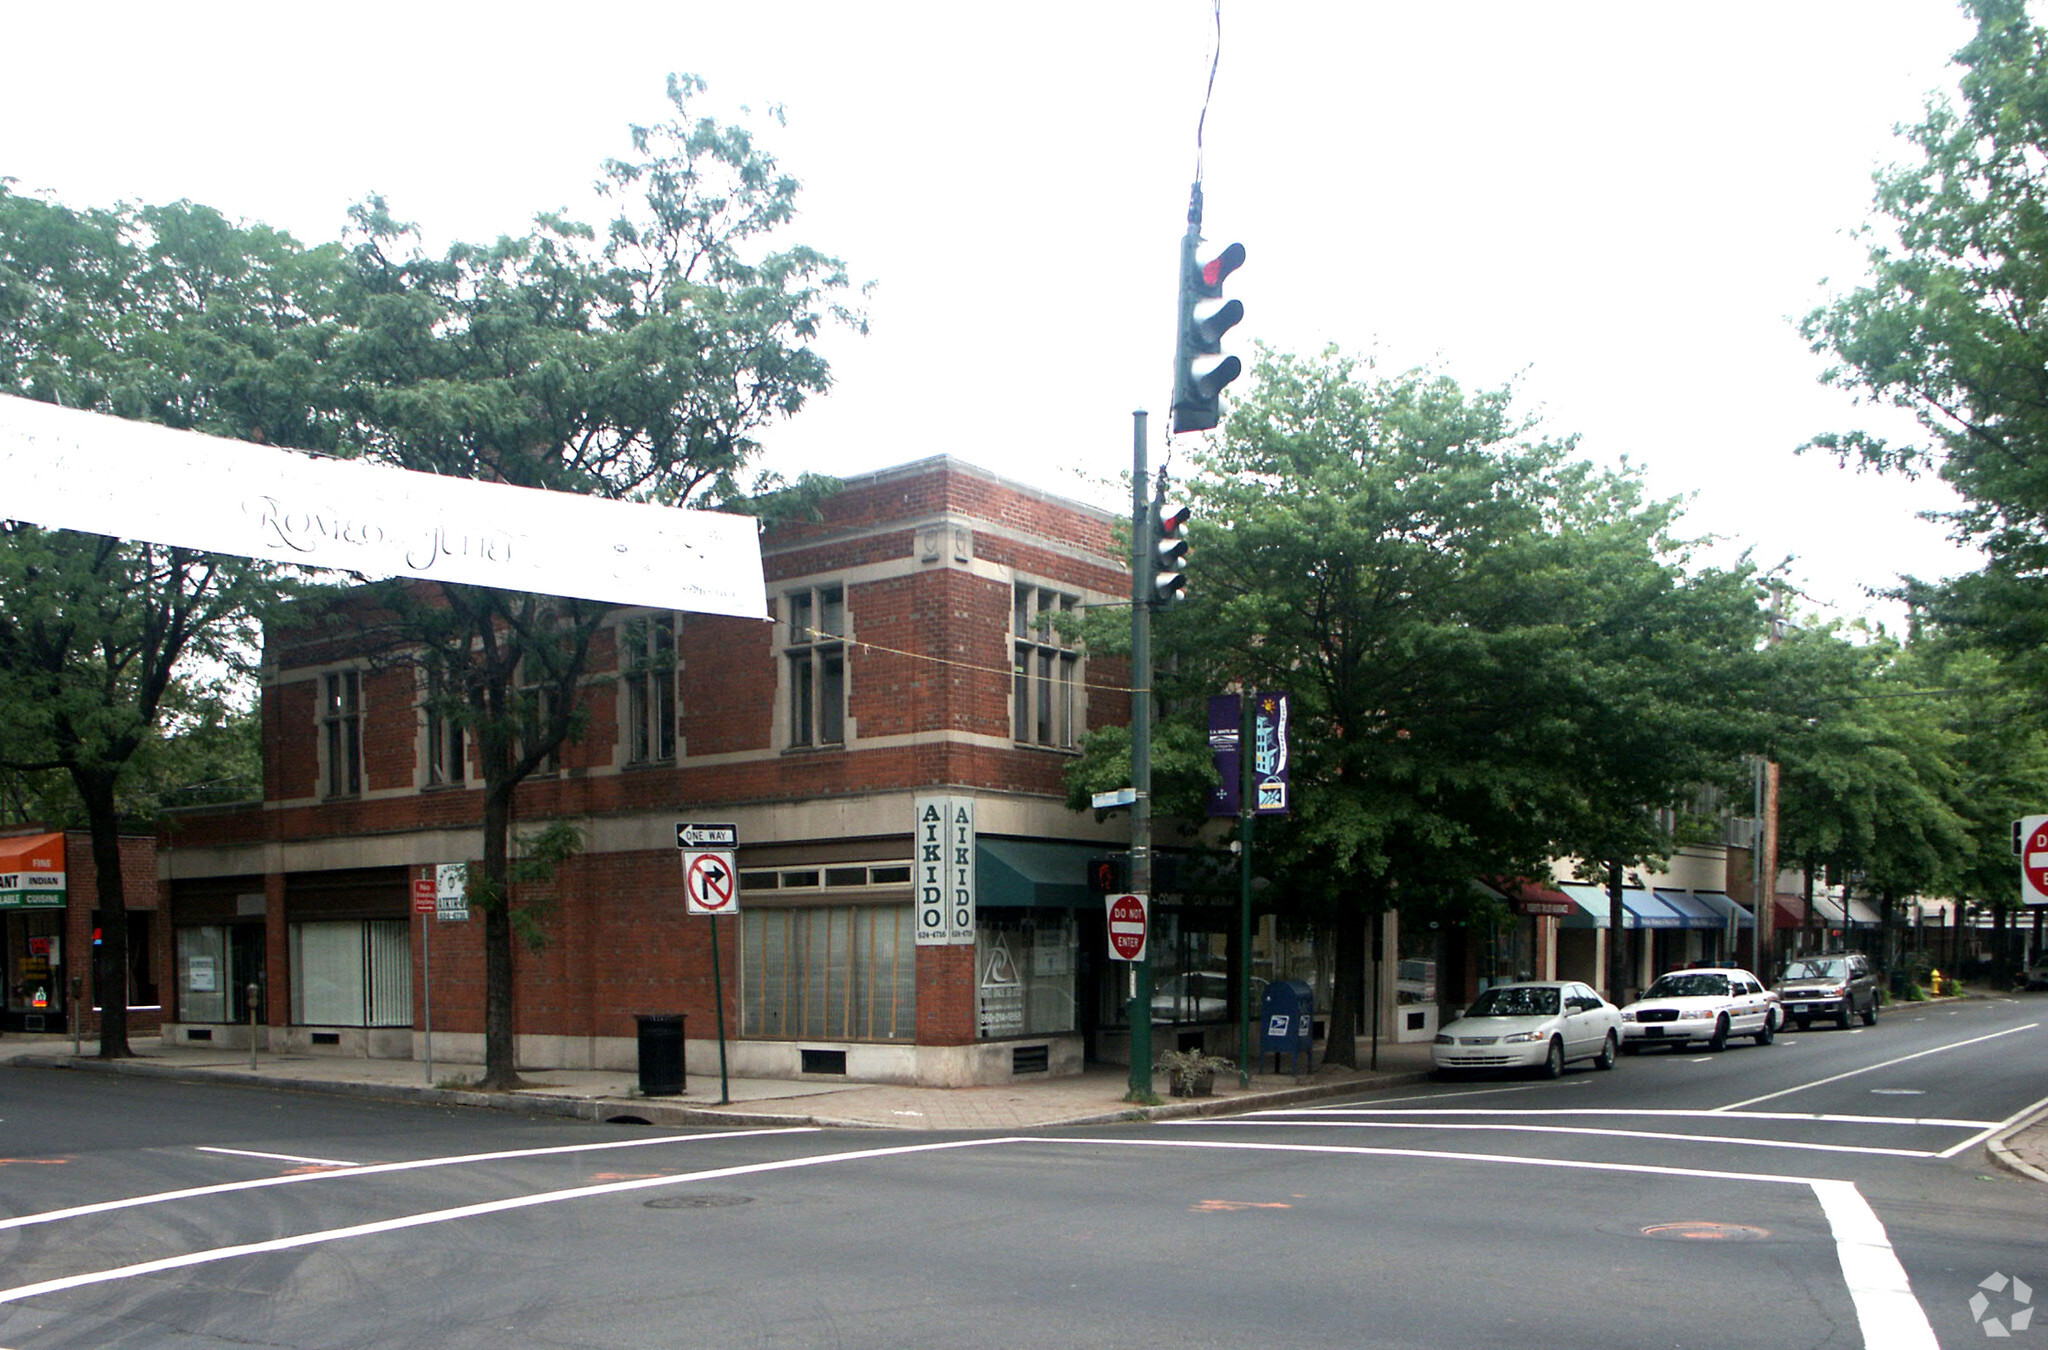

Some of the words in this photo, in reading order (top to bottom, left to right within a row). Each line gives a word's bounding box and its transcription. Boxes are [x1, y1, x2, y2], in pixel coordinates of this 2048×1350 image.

[686, 831, 704, 841] ONE
[708, 831, 726, 840] WAY
[33, 859, 51, 868] FINE
[922, 804, 941, 927] AIKIDO
[955, 806, 969, 927] AIKIDO
[29, 877, 58, 885] INDIAN
[26, 895, 59, 904] CUISINE
[1114, 908, 1126, 918] DO
[1129, 909, 1142, 919] NOT
[1118, 937, 1138, 947] ENTER
